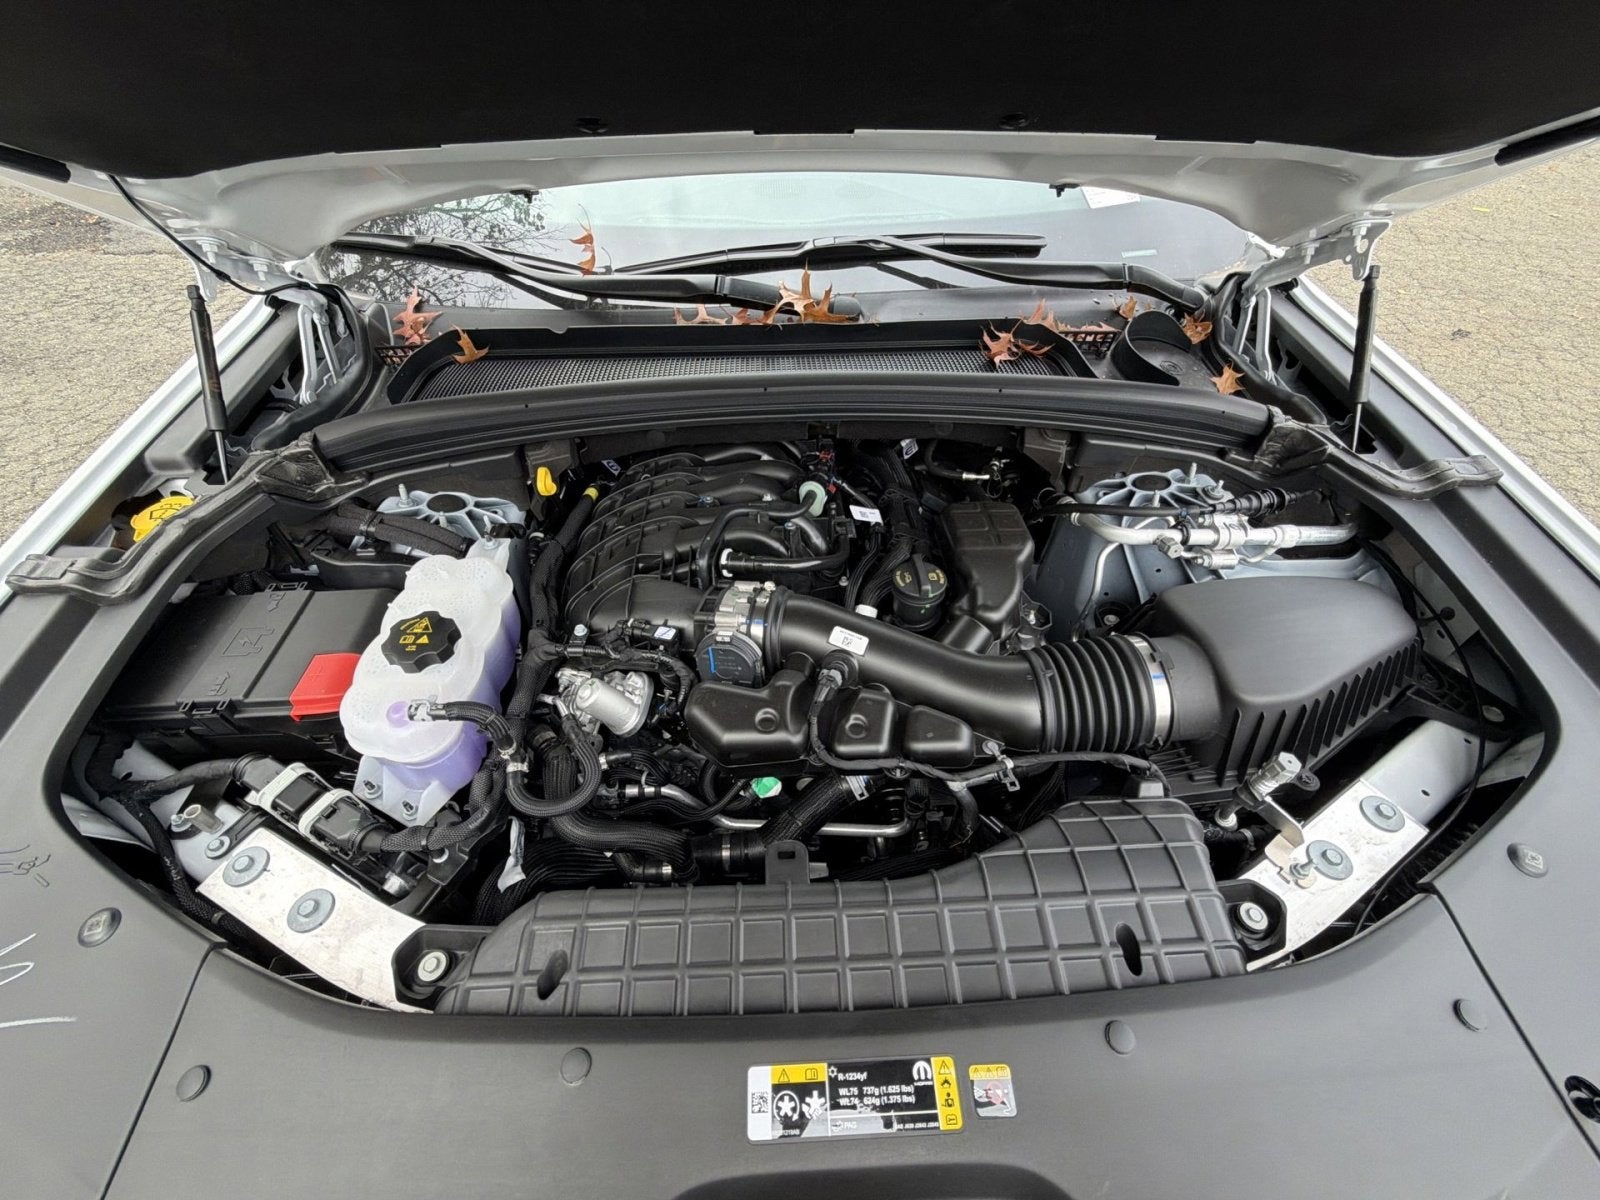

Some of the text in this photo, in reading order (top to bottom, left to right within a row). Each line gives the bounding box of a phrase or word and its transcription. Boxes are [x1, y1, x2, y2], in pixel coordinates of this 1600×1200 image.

[837, 1071, 868, 1082] R-1234yf
[838, 1086, 859, 1096] WL75
[862, 1085, 880, 1096] 737g
[880, 1085, 901, 1095] (1.625
[901, 1084, 915, 1094] lbs)
[881, 1095, 902, 1105] (1.375
[902, 1094, 916, 1104] lbs)
